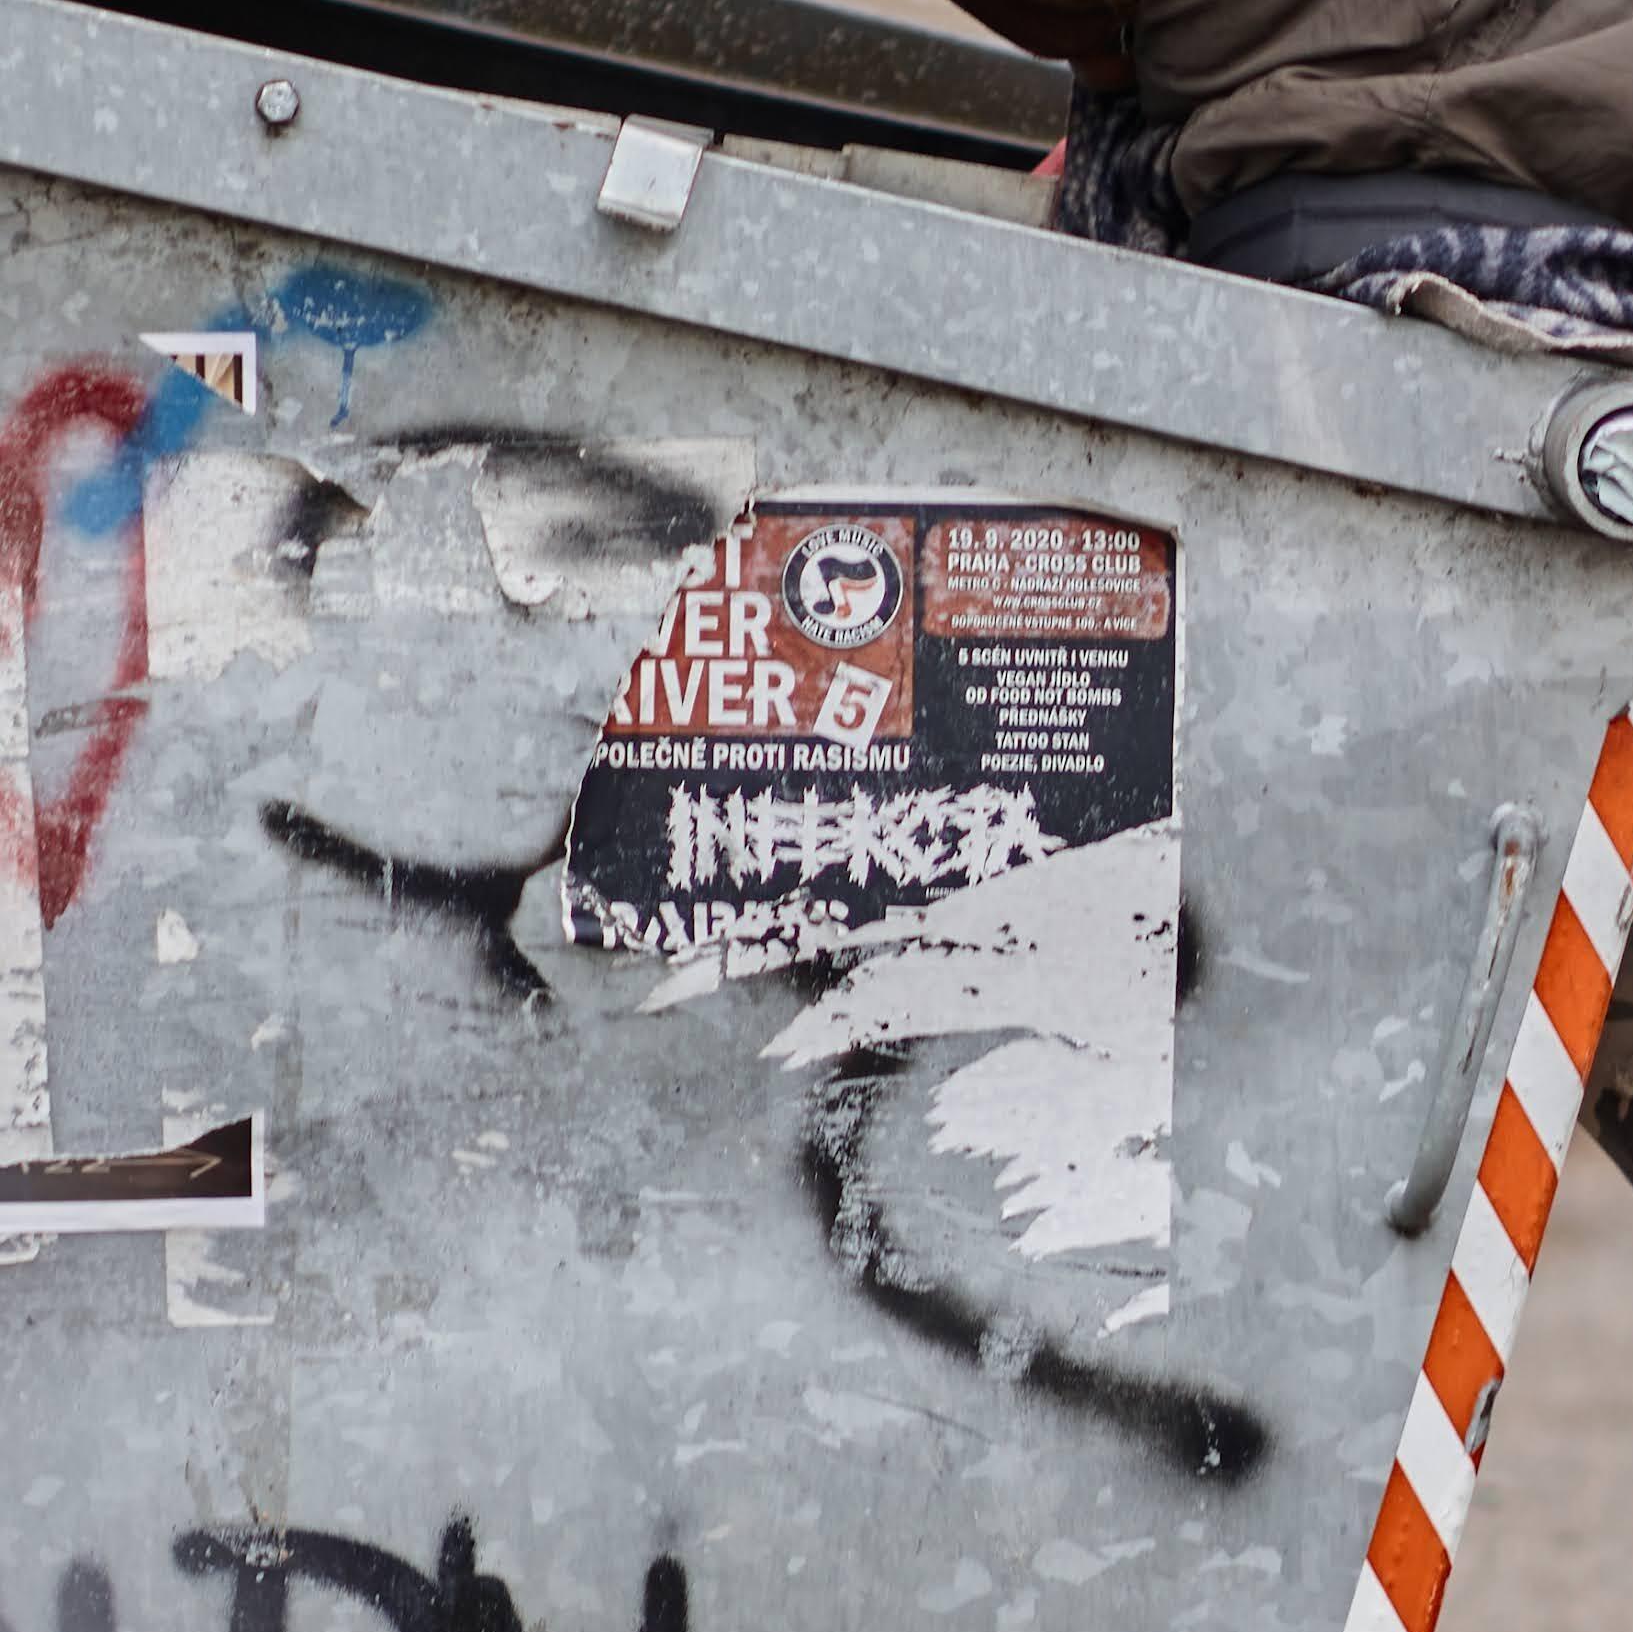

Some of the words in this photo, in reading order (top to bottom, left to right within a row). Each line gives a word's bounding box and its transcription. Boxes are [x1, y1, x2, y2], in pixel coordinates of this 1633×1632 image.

[801, 531, 835, 557] LOVE
[838, 529, 884, 556] MUSIC
[1010, 528, 1064, 552] 2020
[1082, 529, 1141, 553] 13:00
[948, 552, 1010, 573] PRAHA
[1024, 553, 1088, 574] CROSS
[1091, 554, 1141, 575] CLUB
[947, 576, 990, 591] METRO
[801, 615, 832, 641] HATE
[834, 614, 885, 644] RACISM
[971, 644, 1012, 666] SCÉN
[1015, 645, 1068, 667] UVNITŘ
[1079, 649, 1129, 668] VENKU
[997, 670, 1046, 688] VEGAN
[1049, 667, 1092, 688] JÍDLO
[833, 681, 873, 730] 5
[965, 686, 988, 705] OD
[990, 687, 1031, 705] FOOD
[1033, 688, 1063, 706] NOT
[1066, 688, 1122, 707] BOMBS
[999, 704, 1088, 728] PŘEDNÁŠKY
[995, 731, 1049, 750] TATTOO
[1051, 732, 1090, 751] STAN
[712, 742, 786, 772] PROTI
[793, 743, 911, 773] RASISMU
[981, 753, 1037, 774] POEZIE,
[1041, 754, 1106, 773] DIVADLO
